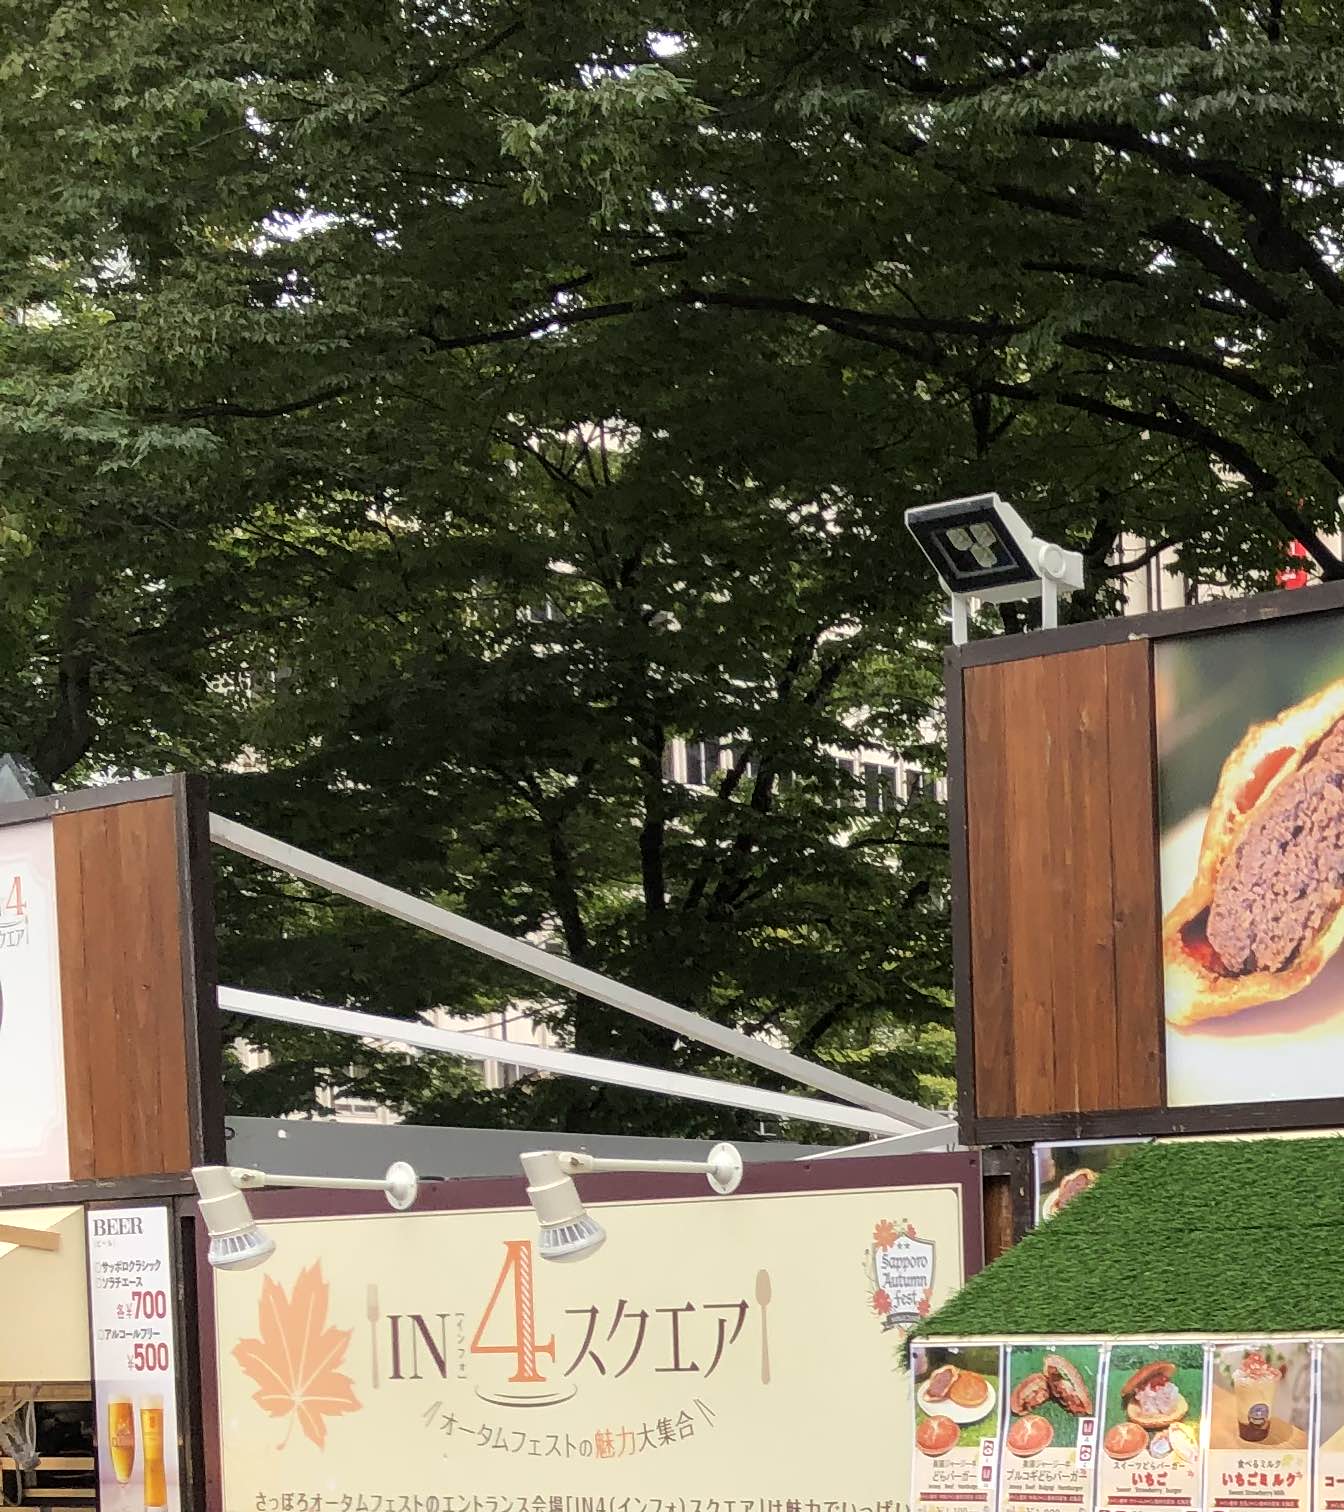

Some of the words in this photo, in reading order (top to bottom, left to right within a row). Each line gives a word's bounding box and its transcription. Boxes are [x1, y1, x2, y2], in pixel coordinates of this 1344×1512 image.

[6, 876, 27, 915] 4
[93, 1217, 143, 1236] BEER
[102, 1259, 161, 1273] サッポロクラシック
[881, 1253, 928, 1271] Sapporo
[102, 1276, 143, 1289] ソラチエース
[882, 1272, 927, 1288] Autumn
[386, 1313, 450, 1380] IN
[470, 1240, 556, 1382] 4
[563, 1298, 750, 1379] スクエア
[104, 1328, 161, 1340] アルコールフリー
[127, 1342, 169, 1371] ¥500
[440, 1409, 697, 1460] オータムフェストの魅力大集合
[1132, 1472, 1168, 1486] いちご
[1222, 1473, 1296, 1487] いちごミルク
